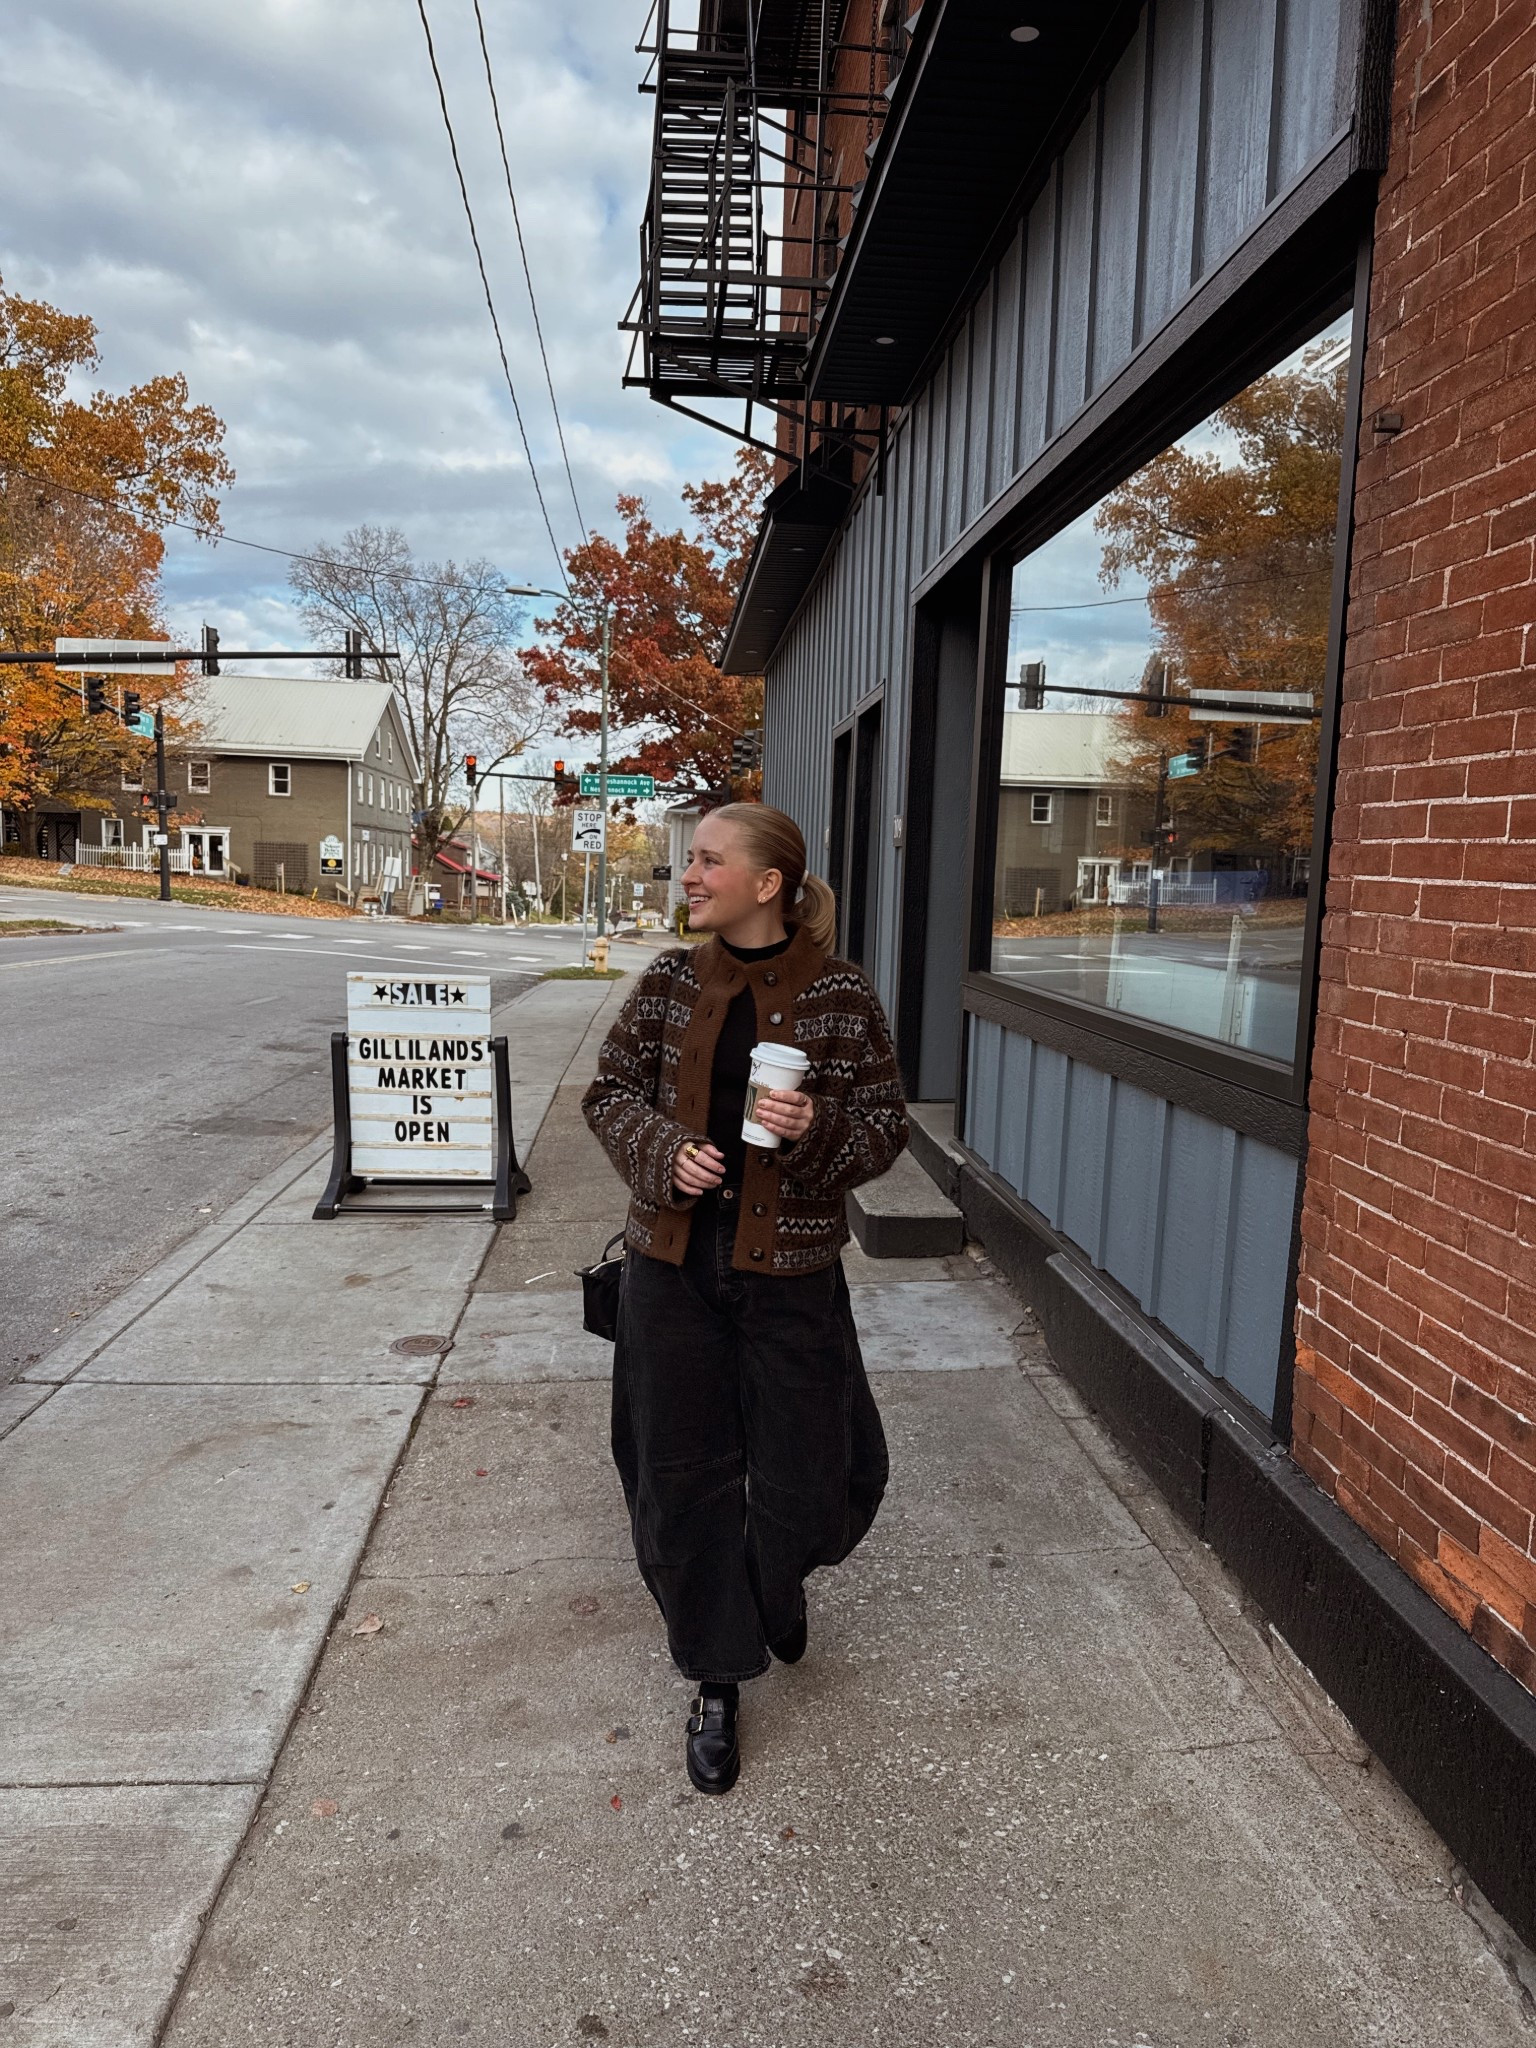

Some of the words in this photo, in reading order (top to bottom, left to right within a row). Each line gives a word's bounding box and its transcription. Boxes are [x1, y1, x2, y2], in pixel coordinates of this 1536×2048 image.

[578, 812, 602, 822] STOP
[584, 840, 602, 850] RED
[391, 983, 447, 1006] SALE
[359, 1038, 483, 1062] GILLILANDS
[378, 1067, 466, 1090] MARKET
[412, 1094, 432, 1115] IS
[394, 1120, 449, 1143] OPEN
